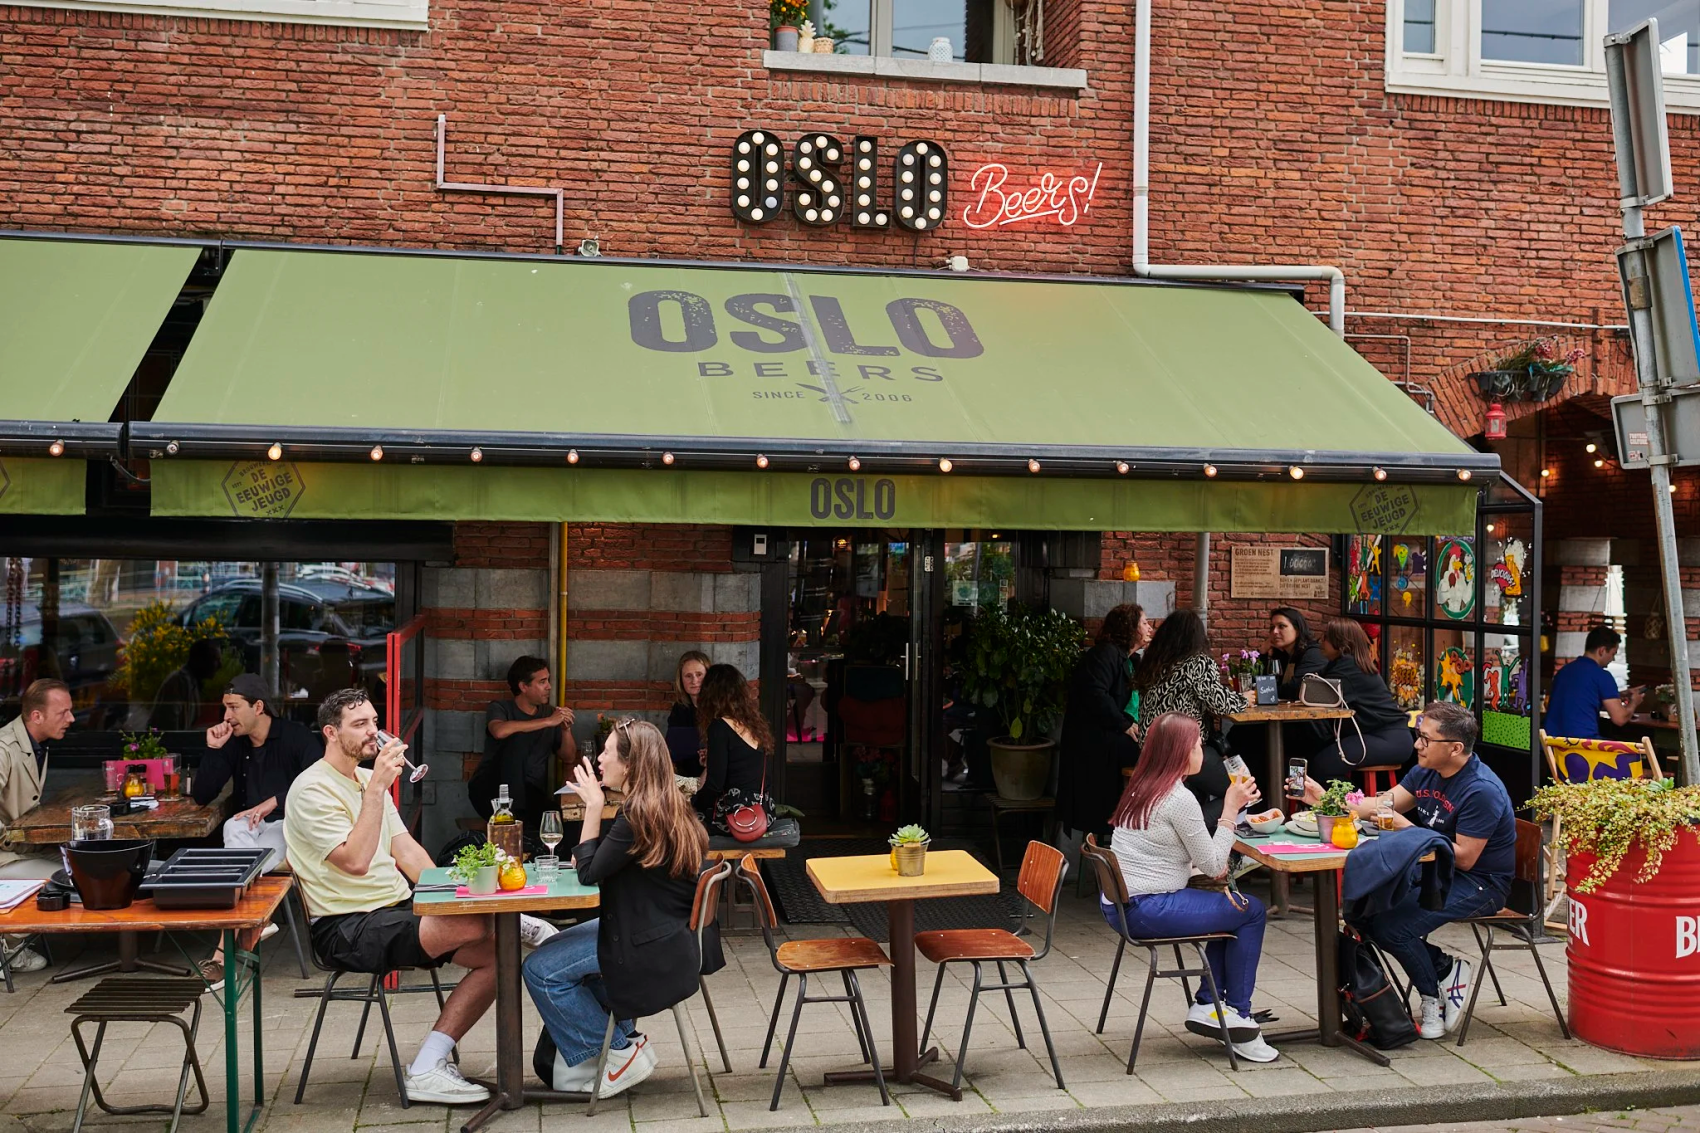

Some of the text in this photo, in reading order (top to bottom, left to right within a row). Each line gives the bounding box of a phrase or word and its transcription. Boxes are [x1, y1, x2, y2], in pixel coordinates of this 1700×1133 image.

[732, 129, 948, 231] OSLO
[963, 161, 1103, 228] Beers!
[628, 290, 985, 359] OSLO
[697, 361, 944, 382] BEERS
[752, 390, 912, 402] SINCE 2006
[236, 472, 293, 504] EEUWIGE
[251, 469, 267, 483] DE
[252, 488, 291, 512] JEUGD
[810, 477, 896, 520] OSLO
[1361, 494, 1409, 522] EEUWIGE
[1375, 491, 1389, 505] DE
[1373, 508, 1406, 529] JEUGD
[1234, 548, 1275, 557] GROEN NEST
[1449, 650, 1474, 675] POP
[1675, 915, 1700, 959] B
